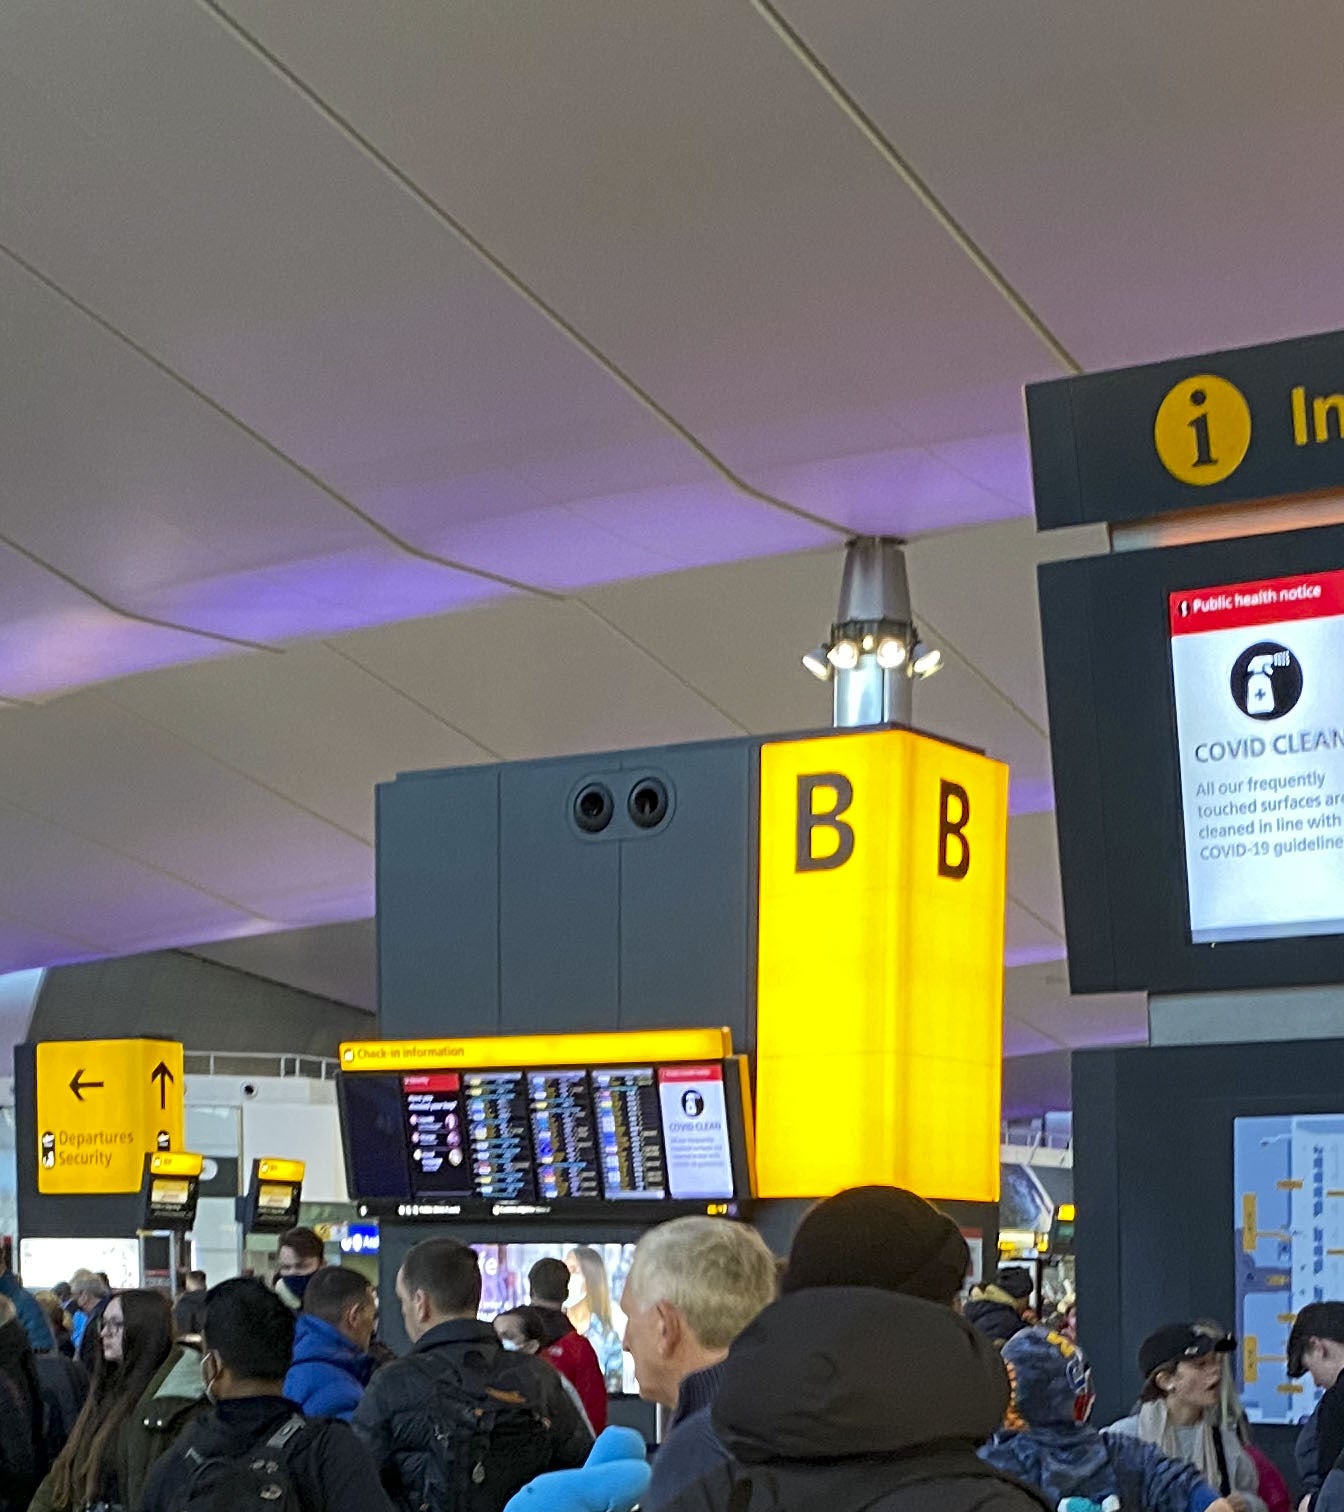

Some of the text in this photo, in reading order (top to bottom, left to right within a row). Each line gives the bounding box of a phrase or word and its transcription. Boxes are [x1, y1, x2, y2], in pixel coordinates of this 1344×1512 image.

[1192, 584, 1322, 613] Public health notice
[1195, 736, 1266, 763] COVID
[1196, 770, 1327, 798] All our frequently
[1197, 798, 1257, 818] touched
[1260, 794, 1322, 813] surfaces
[793, 770, 856, 875] B
[937, 778, 971, 881] B
[1199, 813, 1342, 840] cleaned in line with
[1200, 841, 1270, 861] COVID-19
[357, 1047, 400, 1059] Check-in
[58, 1129, 134, 1147] Departures
[58, 1149, 112, 1169] Security
